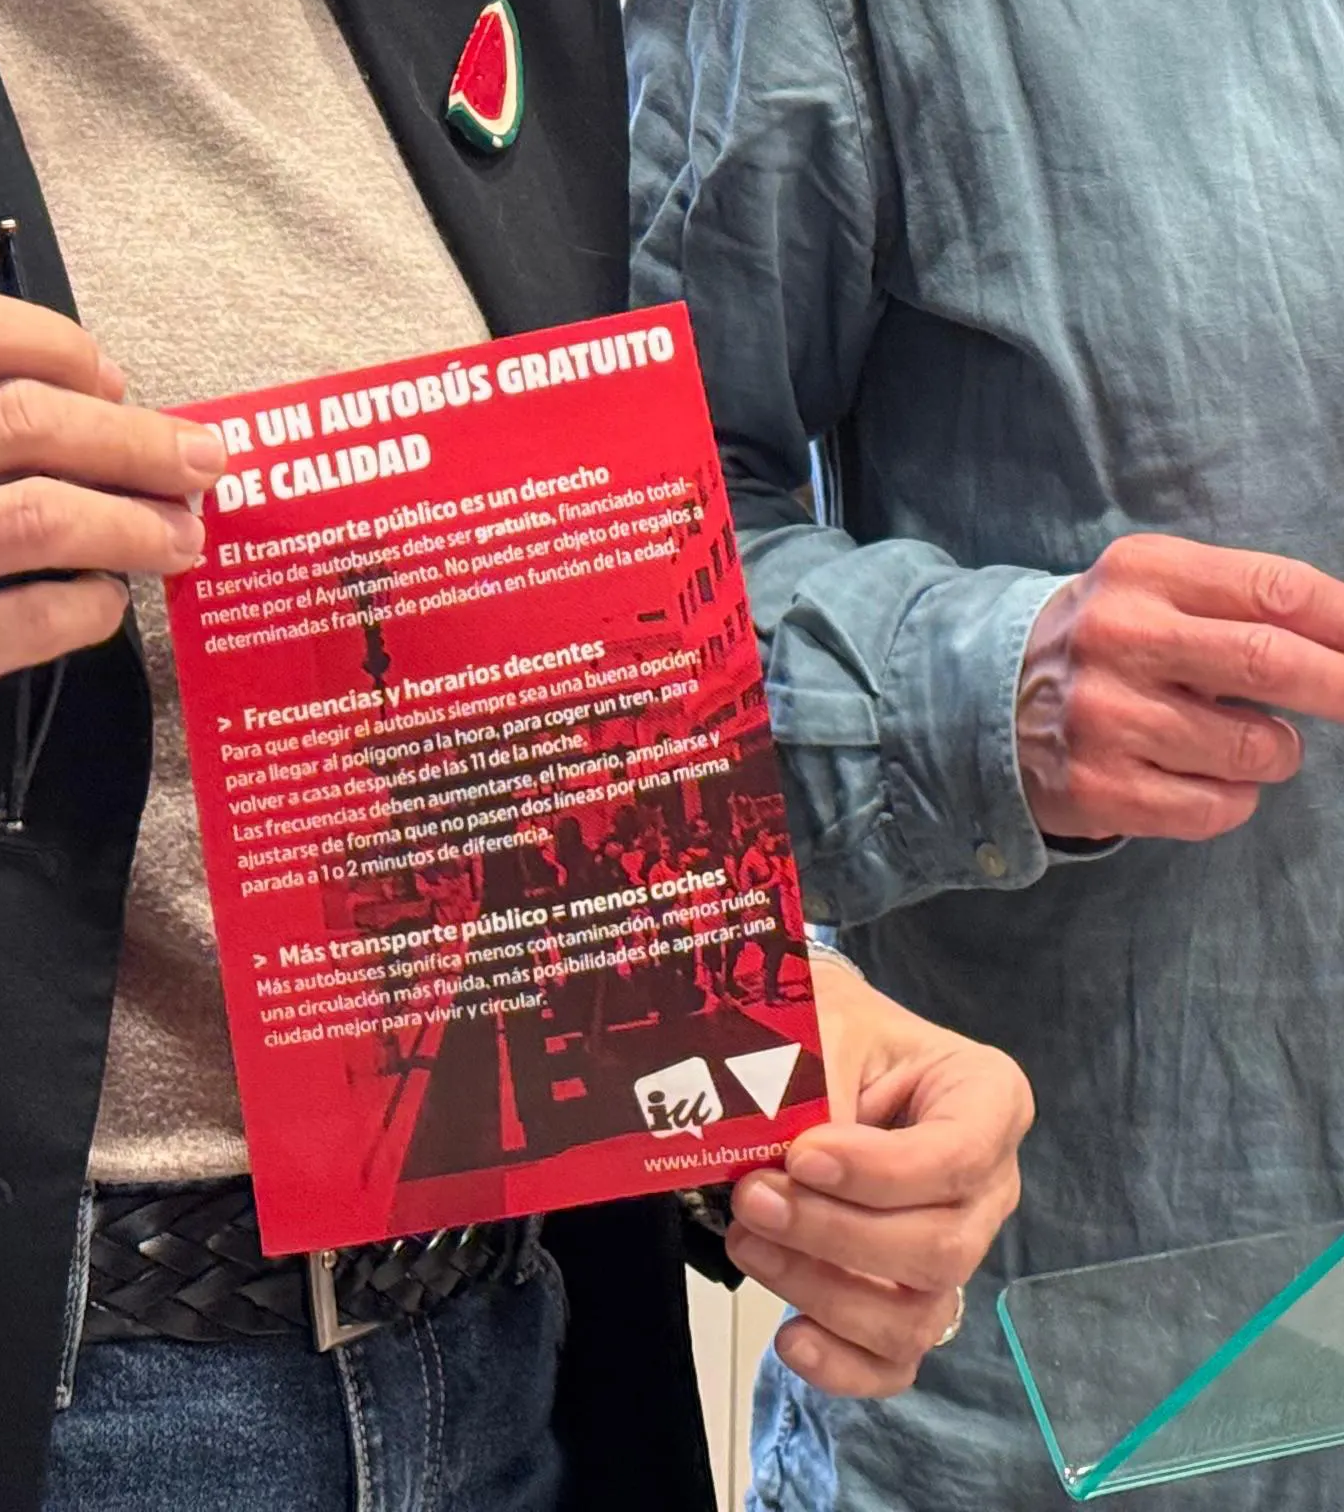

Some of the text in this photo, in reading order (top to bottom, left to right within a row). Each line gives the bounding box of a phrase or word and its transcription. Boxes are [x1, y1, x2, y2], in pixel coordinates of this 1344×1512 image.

[254, 401, 314, 447] UN
[318, 360, 493, 435] AUTOBÚS
[495, 325, 675, 394] GRATUITO
[214, 467, 267, 512] DE
[268, 432, 431, 500] CALIDAD
[217, 465, 609, 567] El transporte público es un derecho
[194, 578, 213, 599] El
[214, 567, 284, 596] servicio
[285, 562, 310, 583] de
[310, 544, 401, 577] autobuses
[401, 534, 446, 557] debe
[445, 528, 472, 548] ser
[557, 487, 645, 522] financiado
[204, 616, 330, 654] determinadas
[329, 603, 393, 630] franjas
[393, 596, 417, 617] de
[417, 579, 503, 614] población
[503, 574, 527, 593] en
[526, 557, 592, 586] función
[592, 551, 615, 572] de
[613, 547, 633, 566] la
[242, 639, 605, 730] Frecuencias y horarios decentes
[255, 977, 292, 997] Más
[293, 964, 386, 992] autobuses
[386, 951, 462, 978] significa
[463, 941, 525, 964] menos
[661, 899, 720, 926] menos
[278, 942, 327, 968] Más
[327, 923, 458, 960] transporte
[460, 906, 548, 941] público
[569, 885, 648, 918] menos
[649, 867, 727, 900] coches
